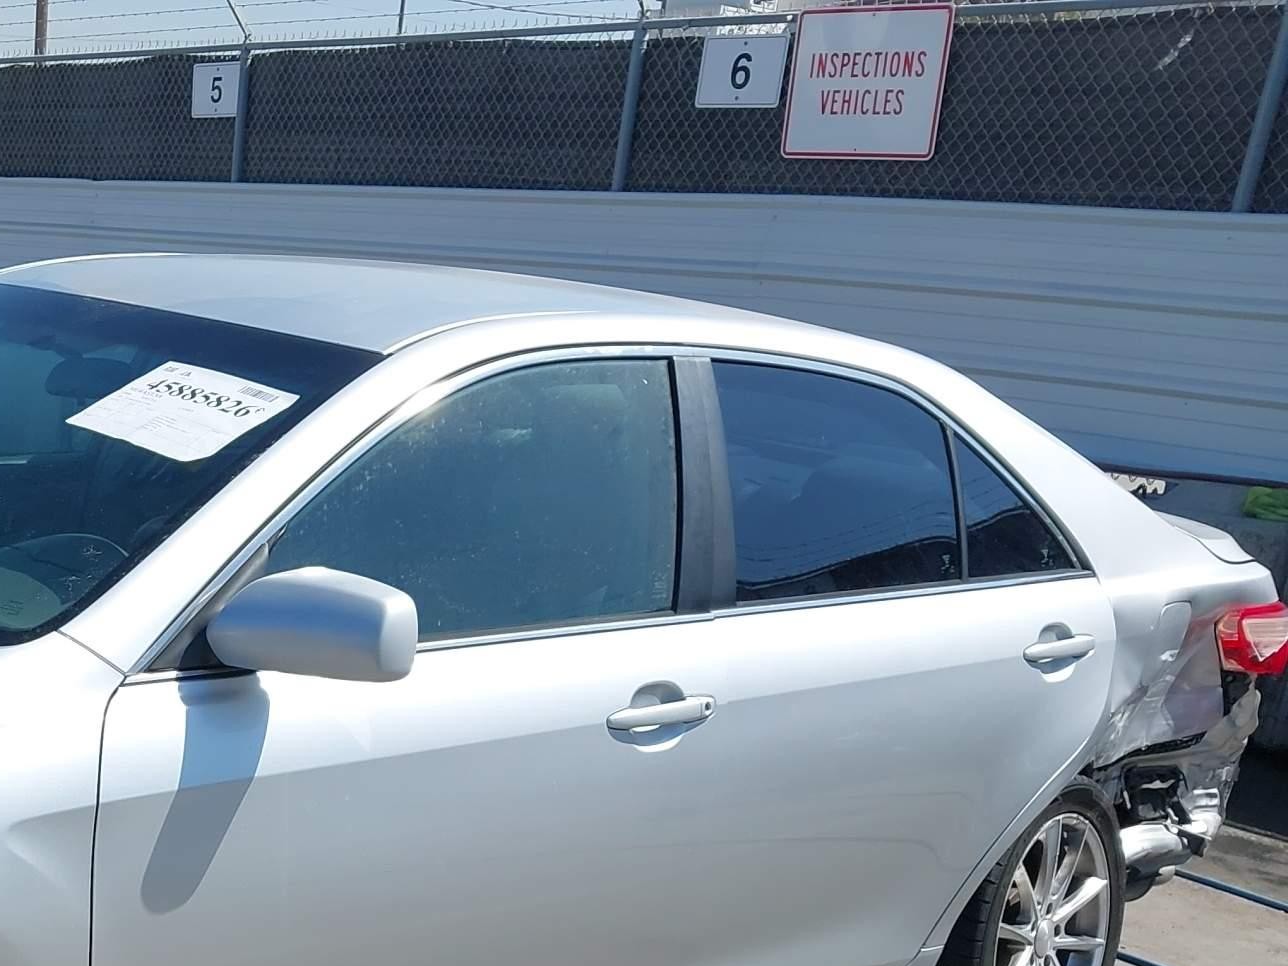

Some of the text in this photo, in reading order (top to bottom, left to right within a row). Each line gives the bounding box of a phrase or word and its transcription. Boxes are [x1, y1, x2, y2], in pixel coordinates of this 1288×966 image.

[730, 52, 753, 90] 6
[809, 50, 928, 79] INSPECTIONS
[210, 76, 223, 104] 5
[820, 89, 905, 115] VEHICLES
[146, 378, 256, 418] 45885826
